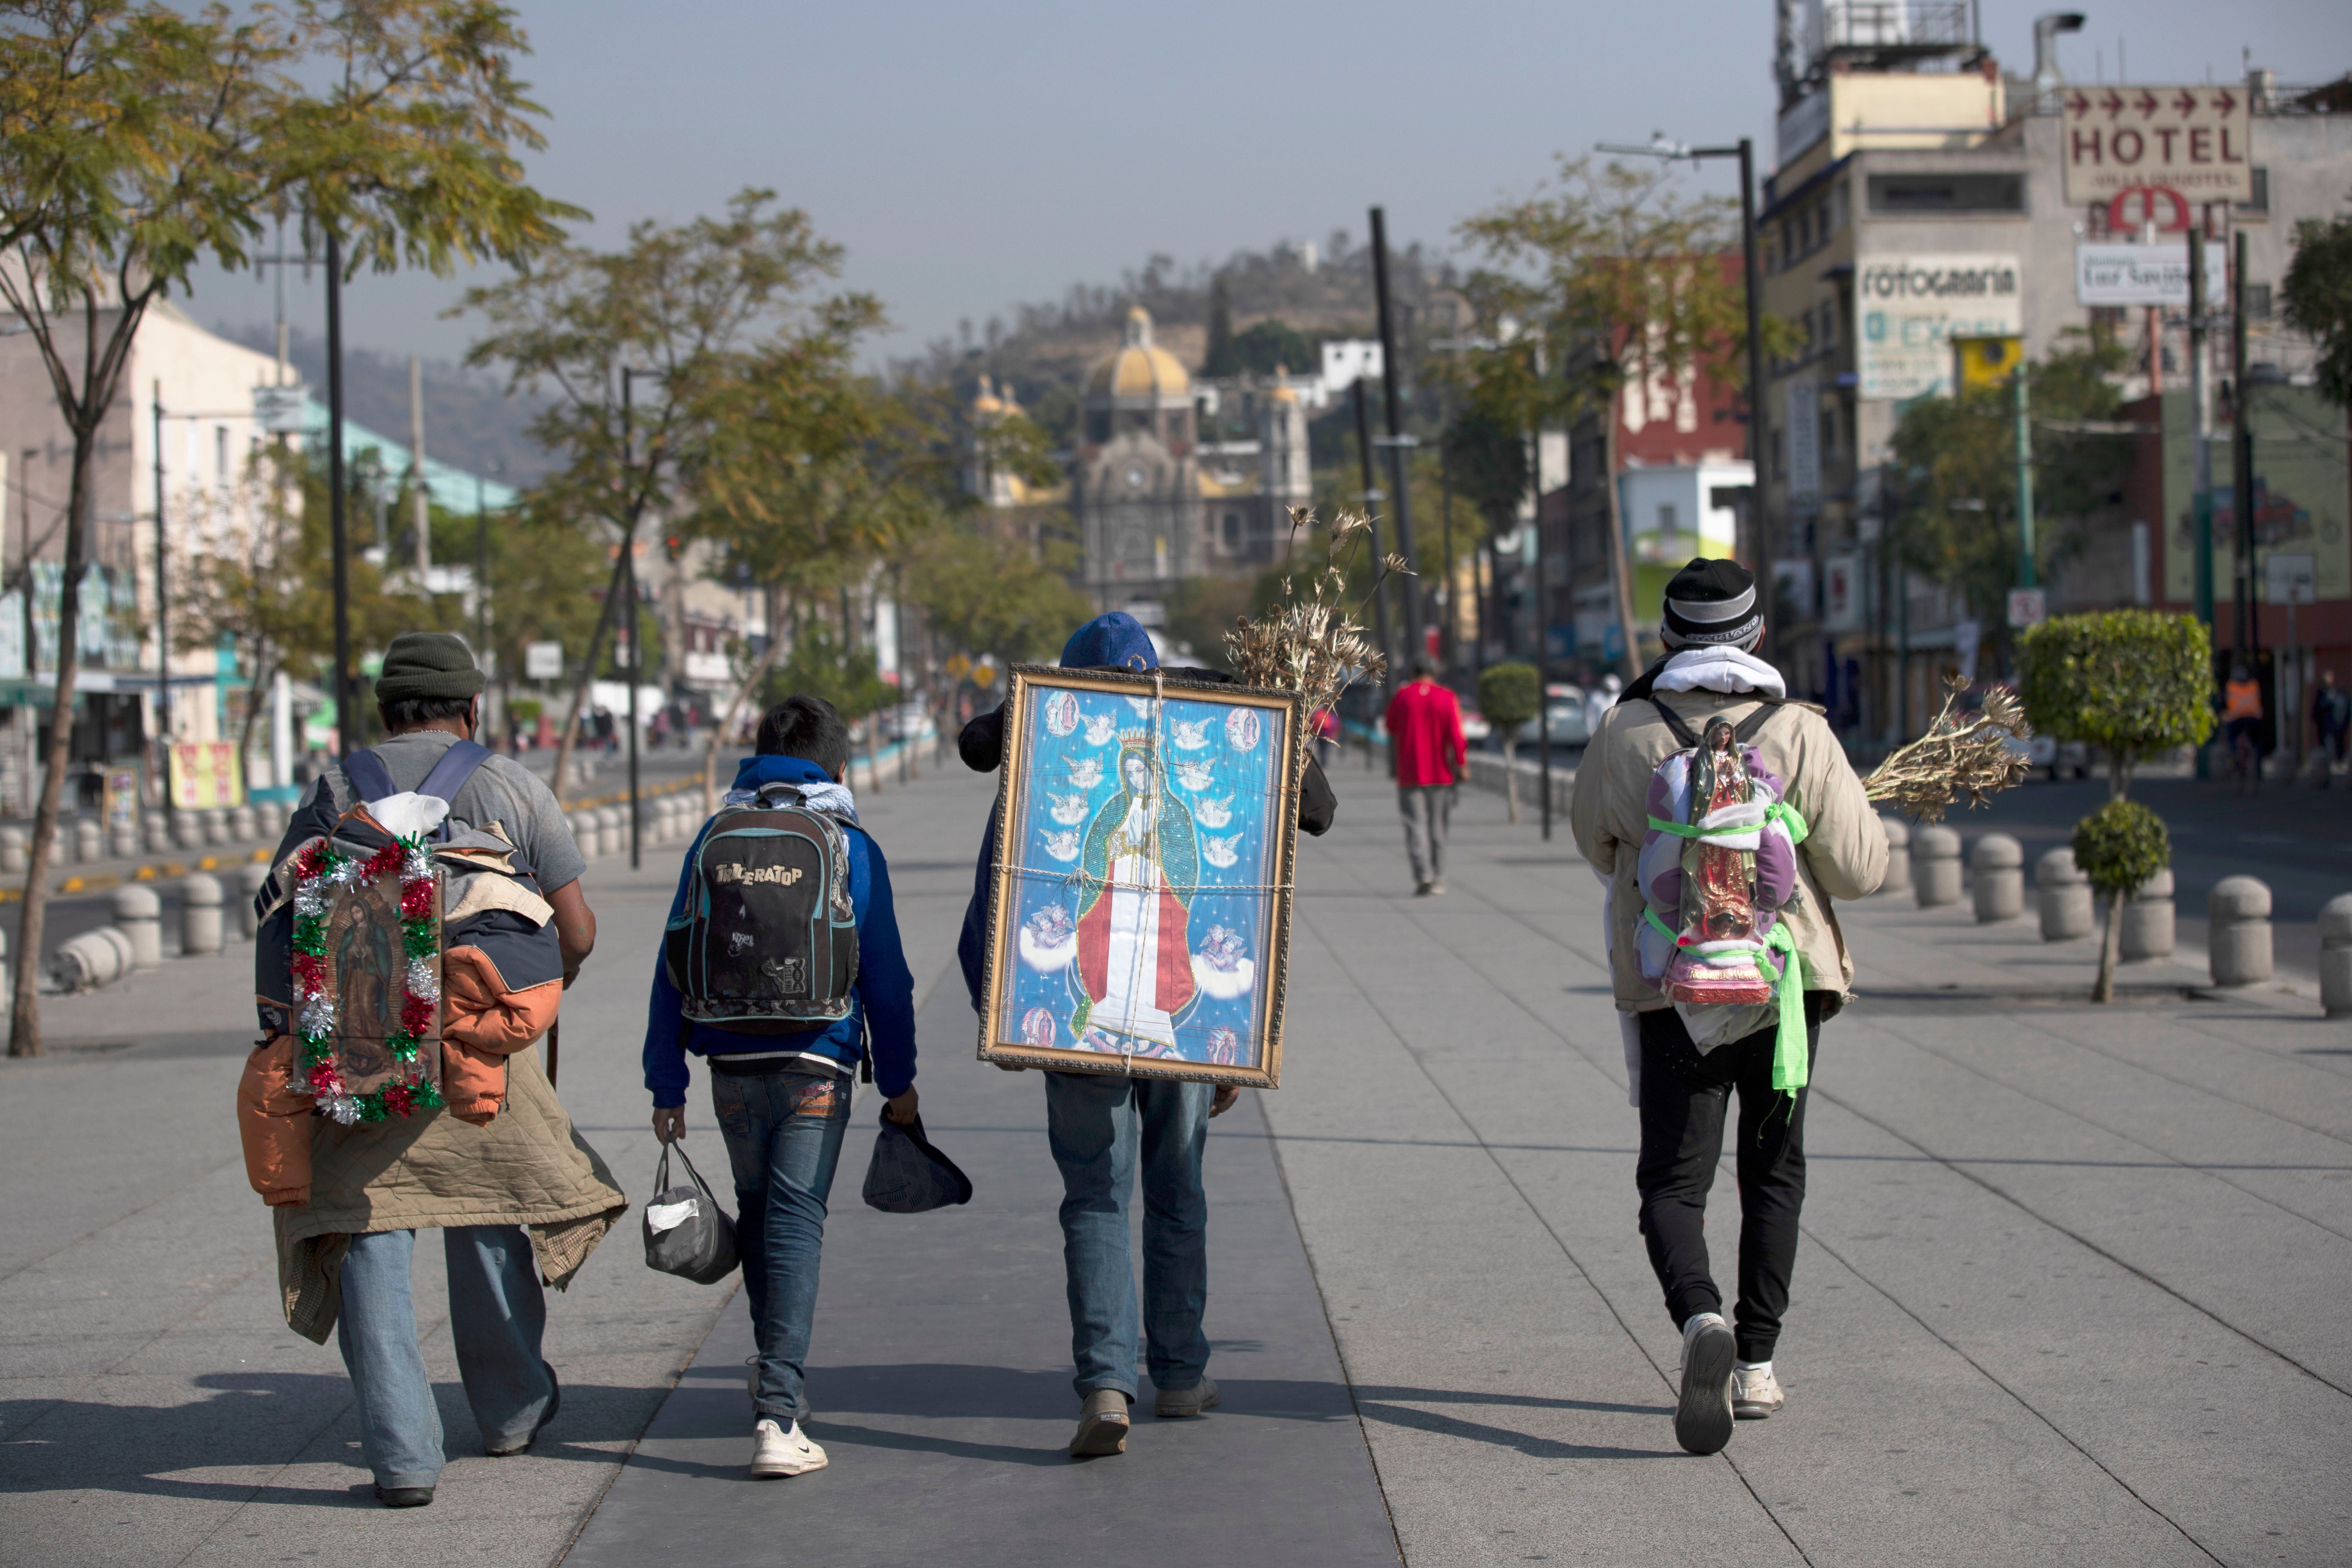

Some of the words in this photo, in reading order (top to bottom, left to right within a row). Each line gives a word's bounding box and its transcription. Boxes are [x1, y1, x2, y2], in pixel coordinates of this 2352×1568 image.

[2071, 128, 2243, 165] HOTEL
[1688, 616, 1758, 641] OAKLAND
[716, 863, 802, 886] TRICERATOP
[796, 1085, 820, 1097] 1922
